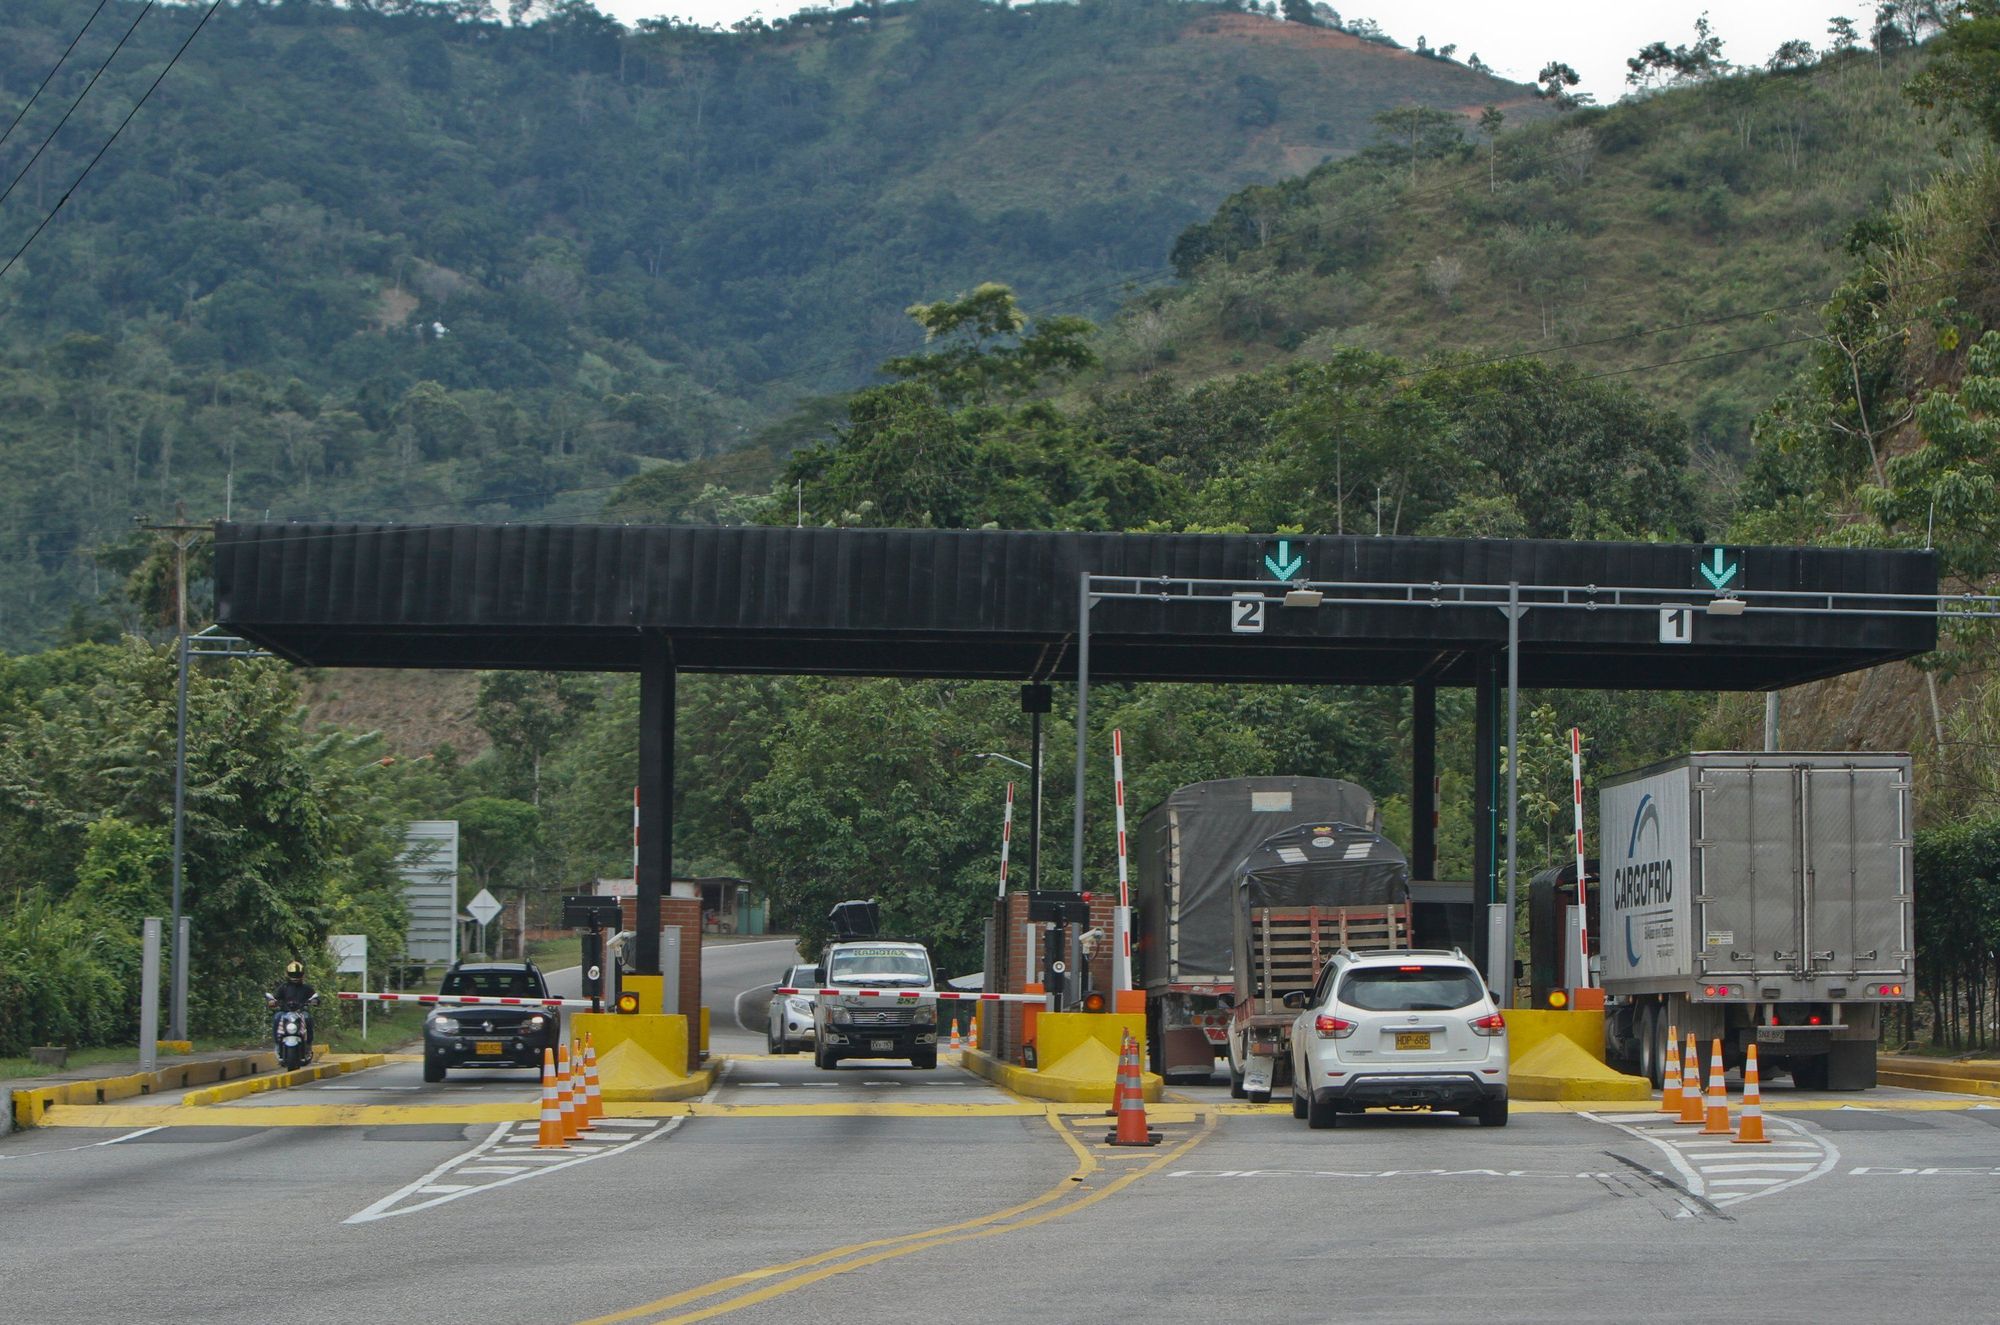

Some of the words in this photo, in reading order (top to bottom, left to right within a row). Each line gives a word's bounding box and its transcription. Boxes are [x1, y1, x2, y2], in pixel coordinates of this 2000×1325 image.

[1237, 600, 1261, 626] 2
[1668, 608, 1684, 637] 1
[1614, 859, 1673, 911] CARGOFRIO
[896, 996, 918, 1005] 287
[1414, 1034, 1429, 1046] 685
